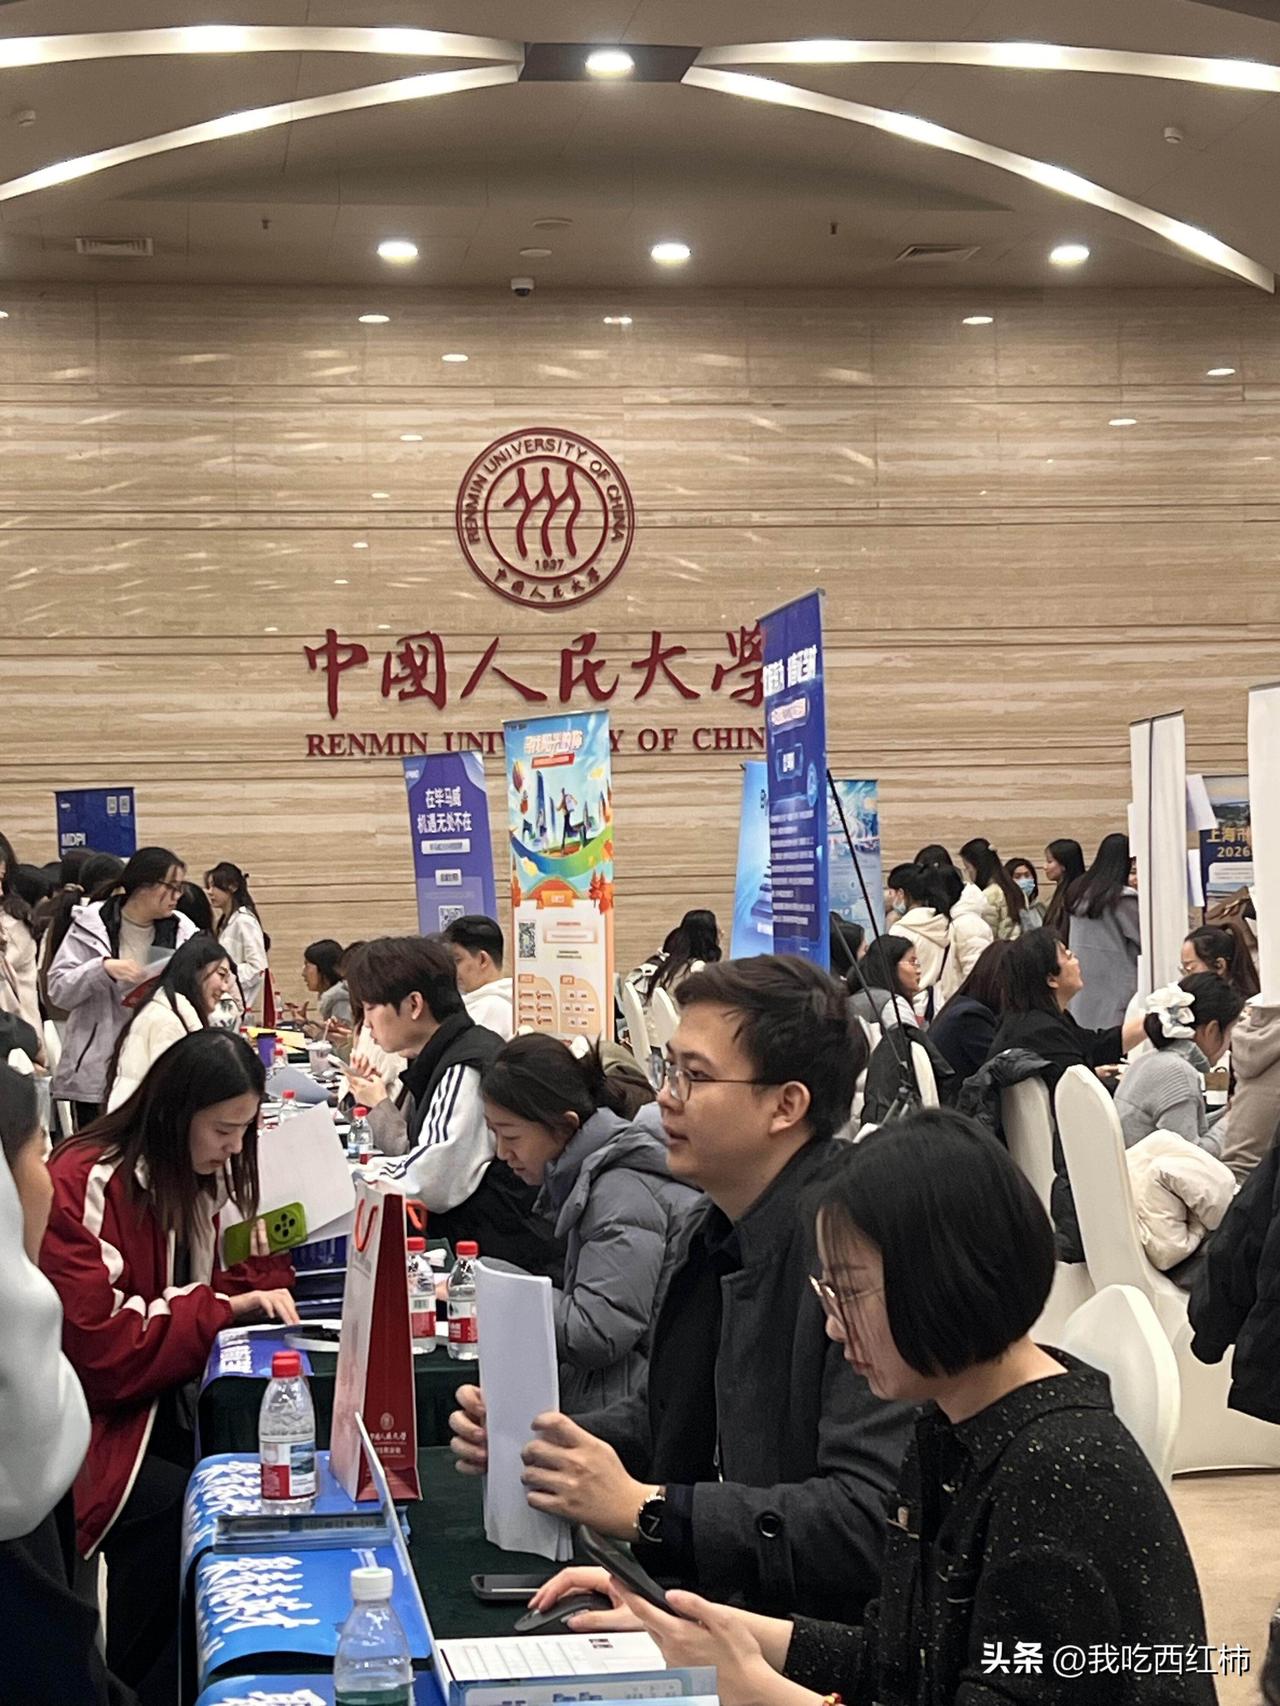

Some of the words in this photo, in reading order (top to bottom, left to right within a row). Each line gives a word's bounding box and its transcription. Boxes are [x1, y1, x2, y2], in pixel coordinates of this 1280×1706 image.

[464, 473, 488, 545] RENMIN
[483, 437, 588, 475] UNIVERSITY
[589, 460, 611, 481] OF
[606, 484, 627, 543] CHINA
[305, 733, 428, 757] RENMIN
[637, 729, 678, 752] OF
[691, 727, 766, 750] CHIN
[1217, 846, 1250, 858] 2026
